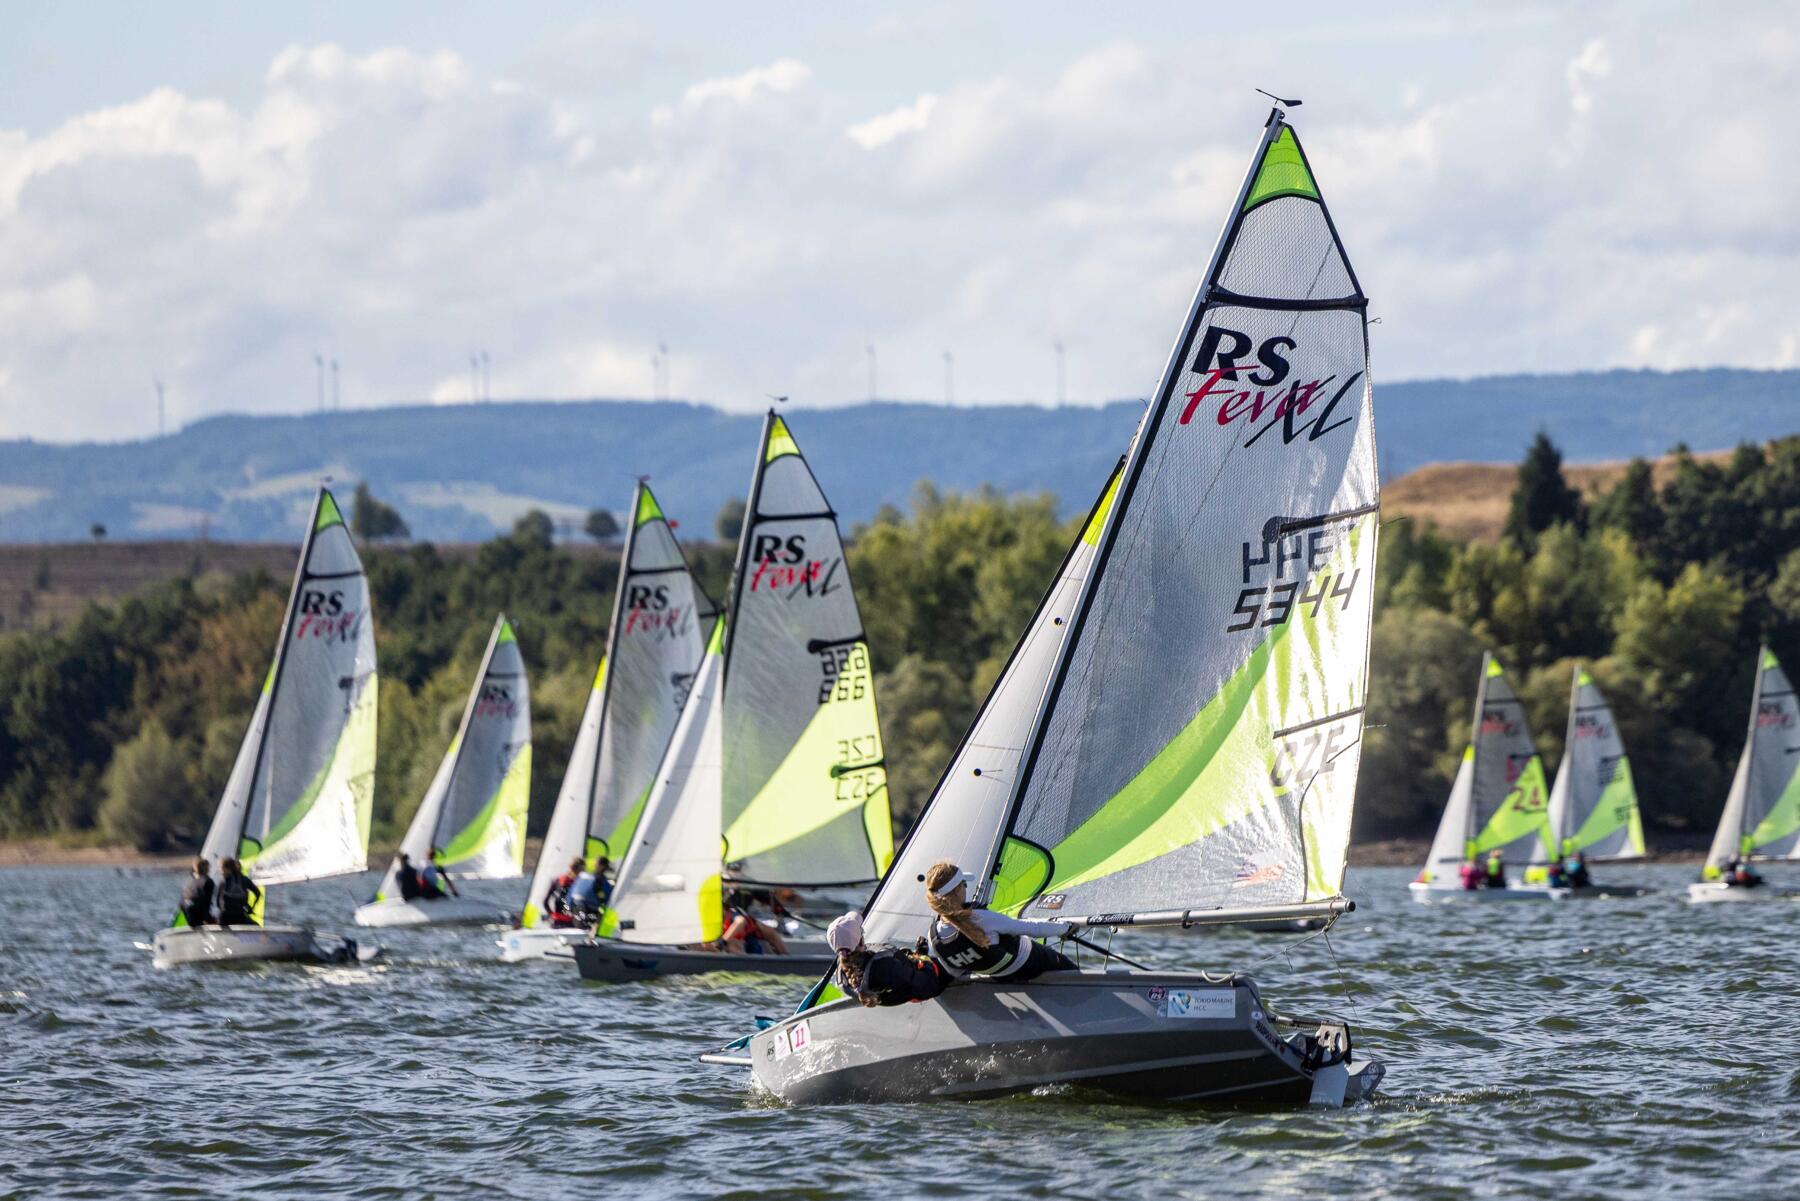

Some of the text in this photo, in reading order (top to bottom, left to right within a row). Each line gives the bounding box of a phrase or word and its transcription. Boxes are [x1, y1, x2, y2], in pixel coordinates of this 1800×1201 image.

[1191, 325, 1297, 387] RS
[1180, 366, 1363, 448] Feva XL
[753, 535, 806, 563] RS
[301, 589, 345, 616] RS
[629, 585, 669, 610] RS
[1226, 568, 1361, 633] 5344
[1270, 724, 1345, 787] CZE
[946, 947, 983, 967] HH
